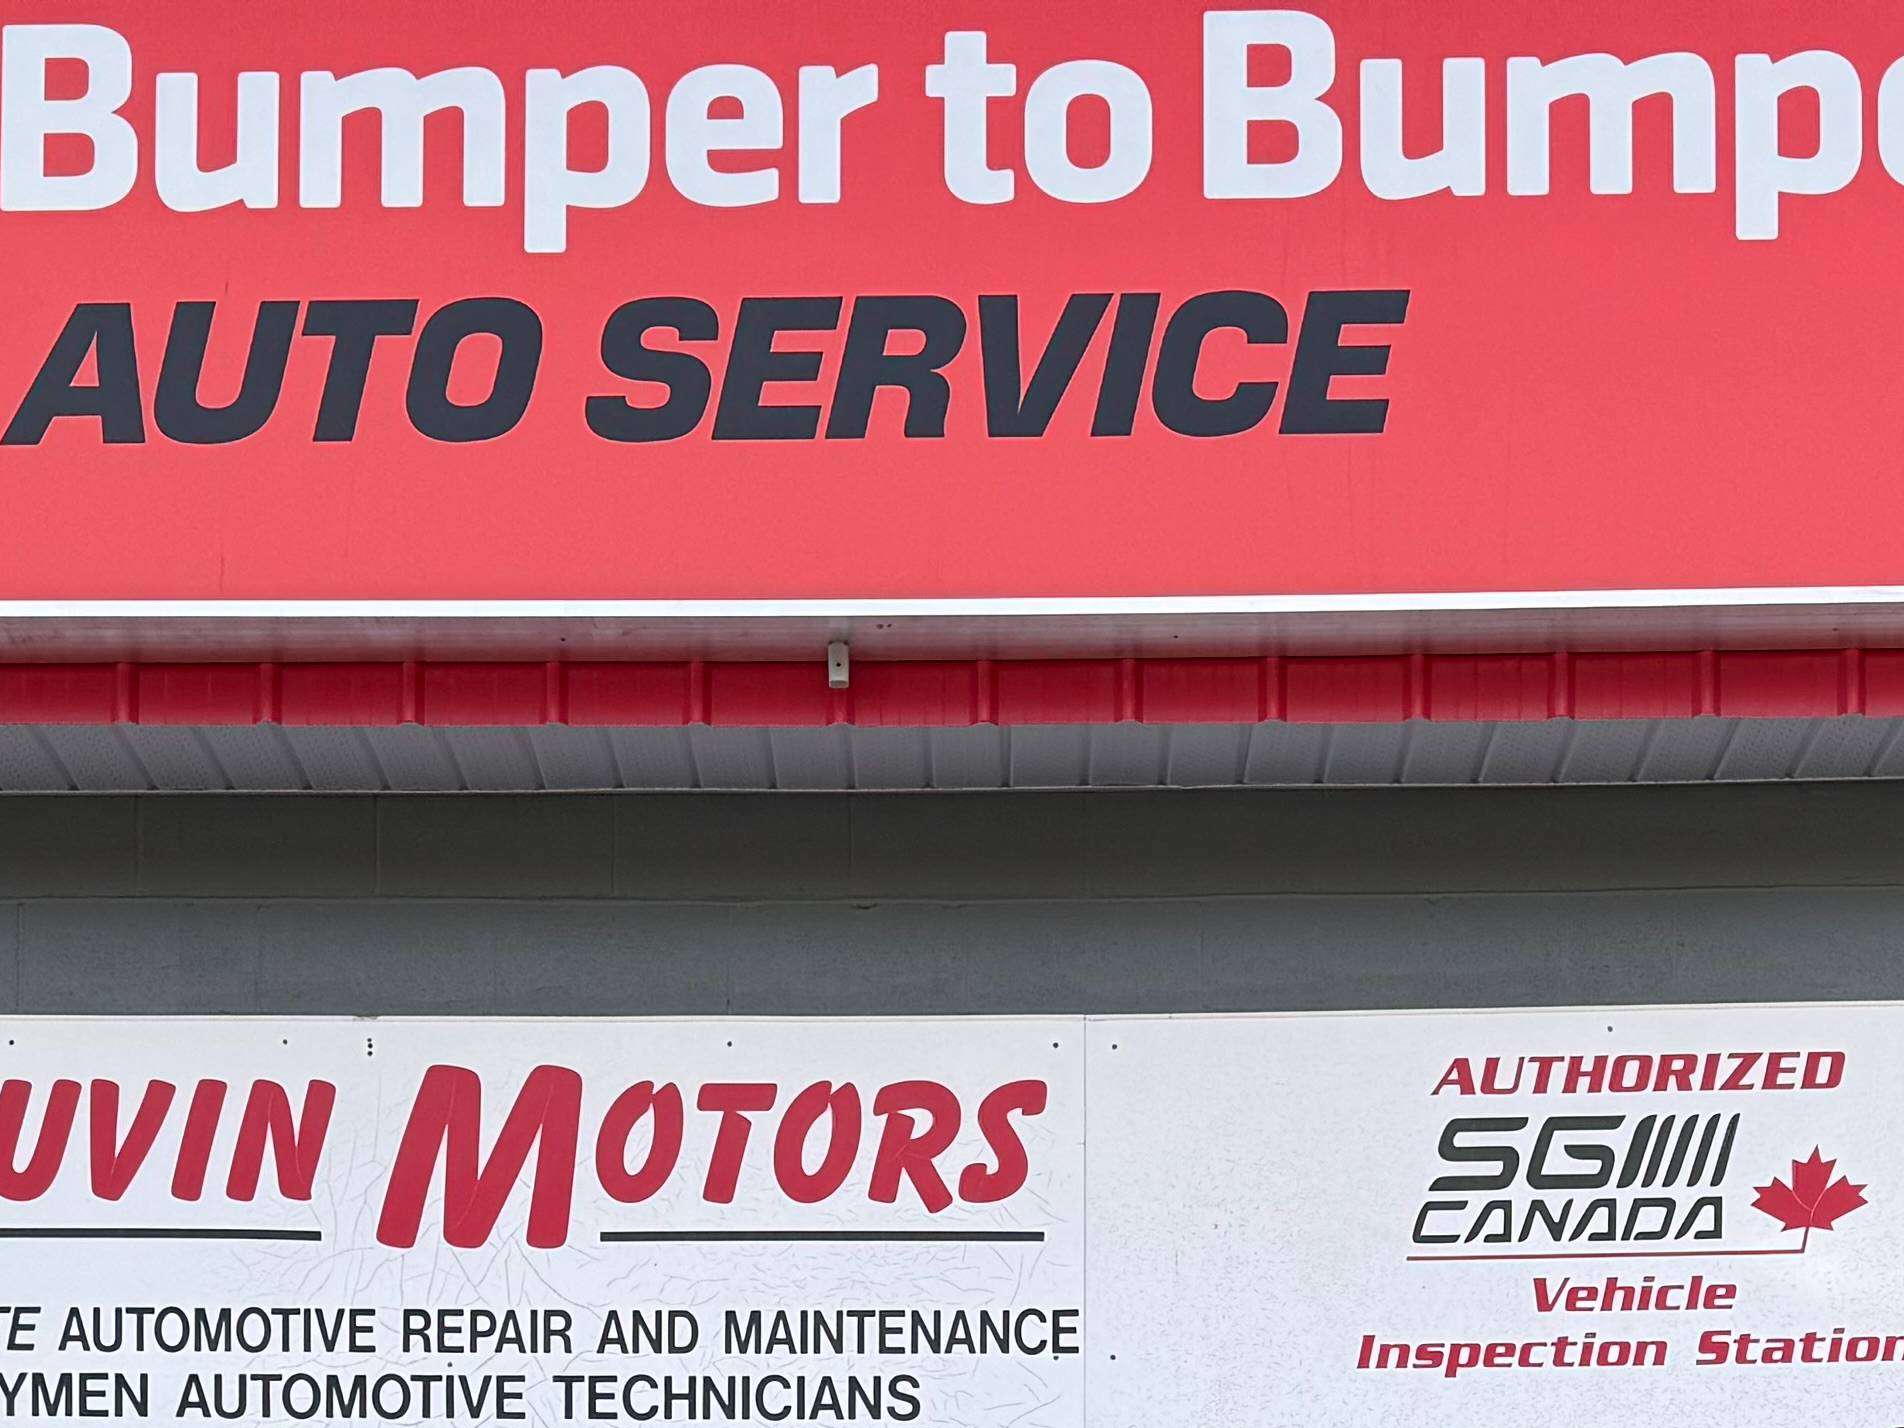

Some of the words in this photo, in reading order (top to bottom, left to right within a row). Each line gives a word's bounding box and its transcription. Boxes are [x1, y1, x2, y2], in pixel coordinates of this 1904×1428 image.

[0, 24, 878, 253] Bumper
[926, 31, 1152, 204] to
[0, 297, 542, 445] AUTO
[585, 290, 1410, 442] SERVICE
[1432, 1051, 1846, 1095] AUTHORIZED
[376, 1064, 1048, 1249] MOTORS
[1413, 1197, 1722, 1243] CANADA
[1531, 1275, 1737, 1313] Vehicle
[59, 1307, 375, 1353] AUTOMOTIVE
[403, 1309, 571, 1353] REPAIR
[597, 1310, 698, 1354] AND
[725, 1309, 1079, 1355] MAINTENANCE
[1356, 1334, 1668, 1377] Inspection
[176, 1373, 525, 1419] AUTOMOTIVE
[553, 1375, 920, 1421] TECHNICIANS
